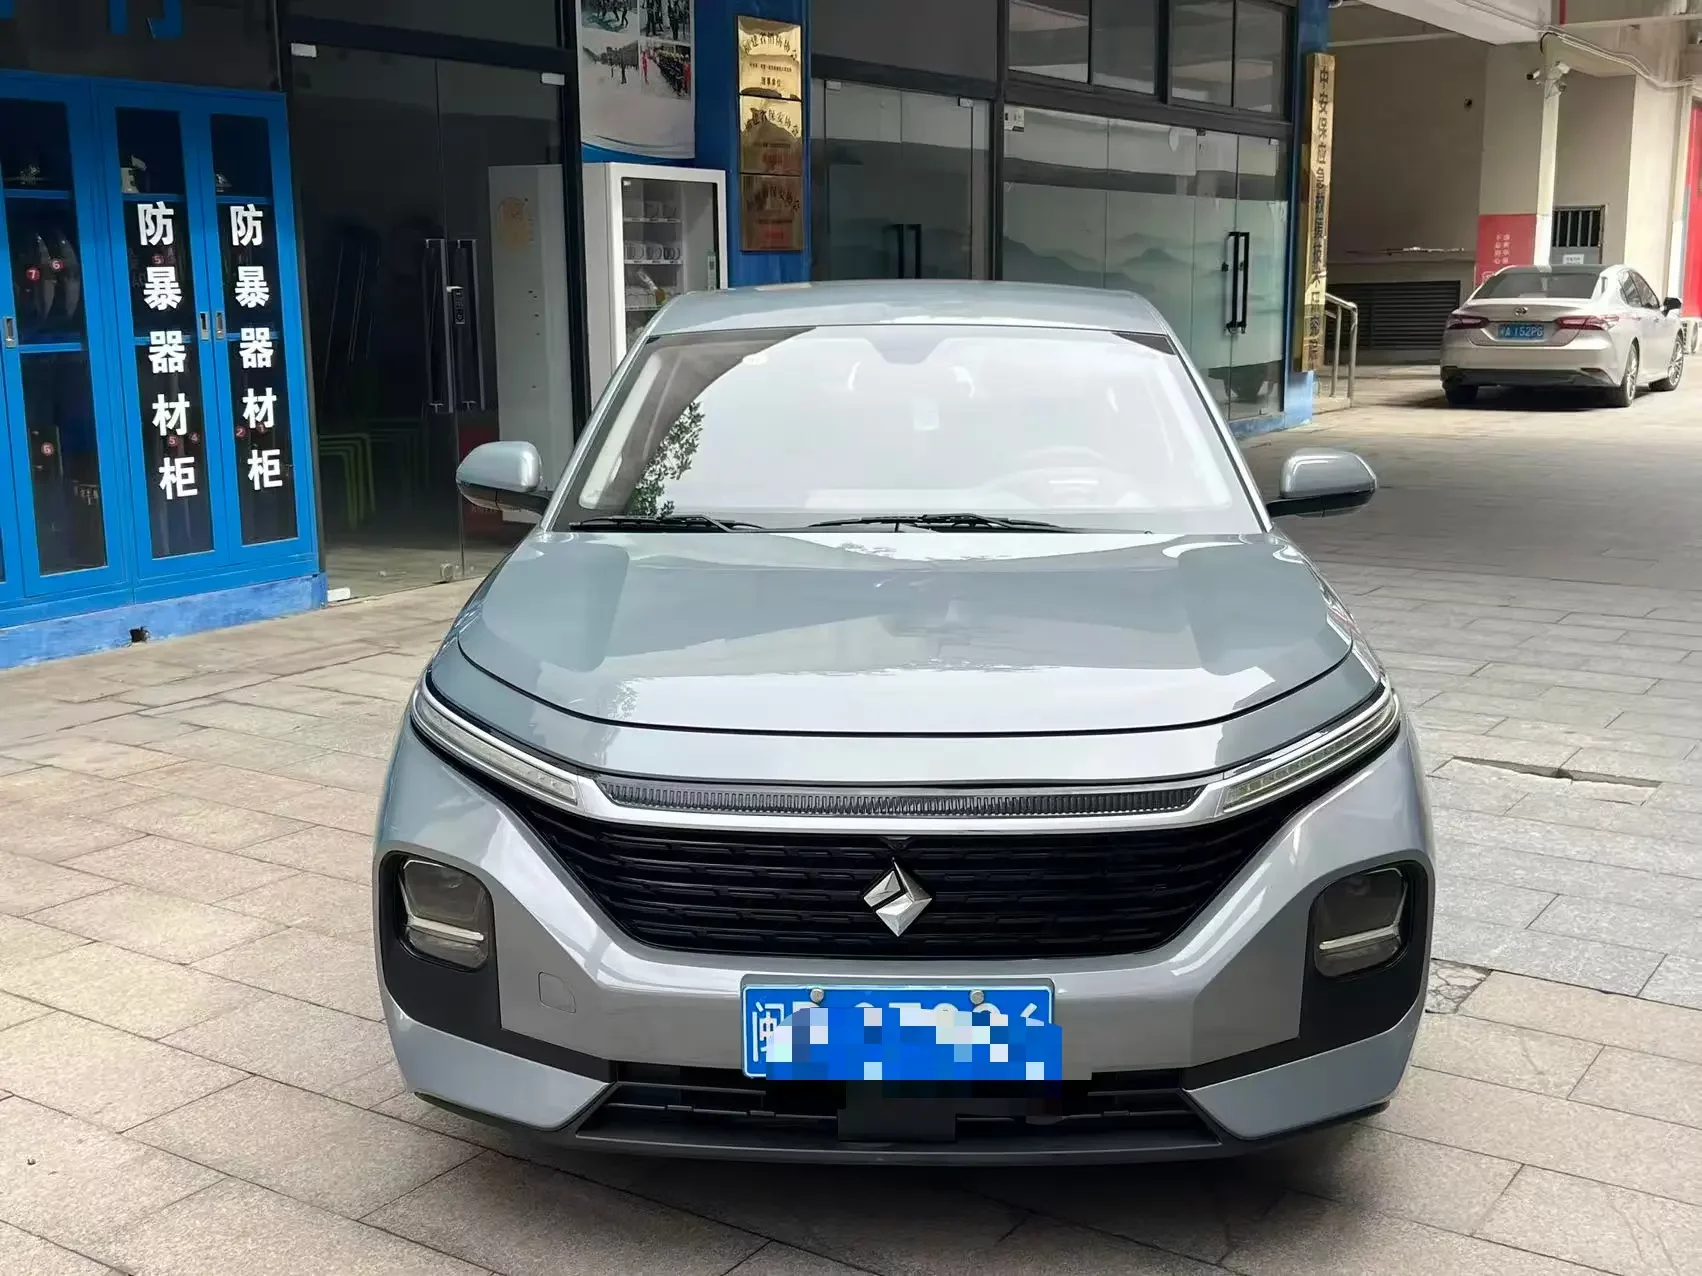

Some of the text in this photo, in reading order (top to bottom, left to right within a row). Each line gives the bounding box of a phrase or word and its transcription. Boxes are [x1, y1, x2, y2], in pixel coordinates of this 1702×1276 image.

[137, 201, 198, 500] 防暴器材柜
[230, 203, 283, 490] 防暴器材柜
